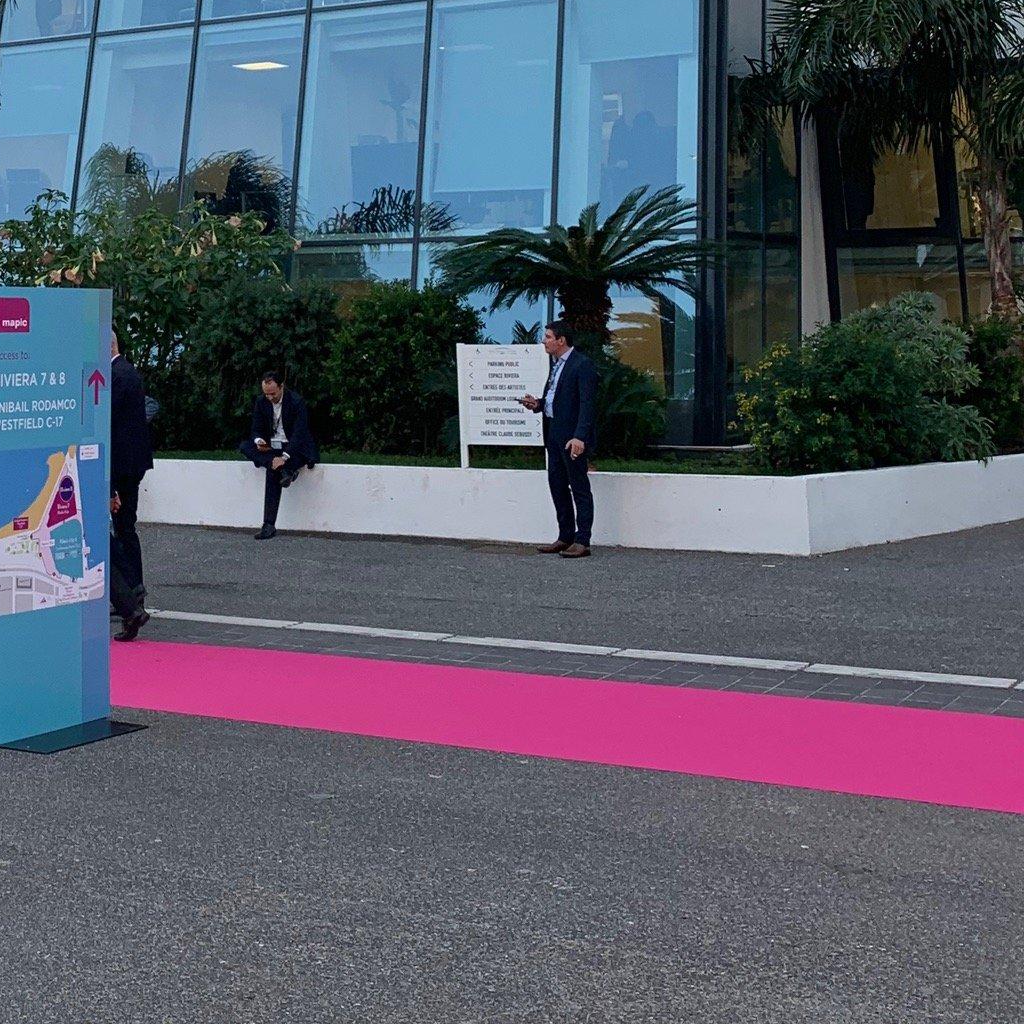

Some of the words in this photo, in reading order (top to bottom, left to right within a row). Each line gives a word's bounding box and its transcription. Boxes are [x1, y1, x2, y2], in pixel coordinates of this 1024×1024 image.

[2, 317, 28, 329] mapic
[40, 372, 47, 385] 7
[49, 372, 57, 386] &
[59, 371, 66, 385] 8
[32, 398, 77, 411] RODAMCO
[46, 416, 64, 428] C-17
